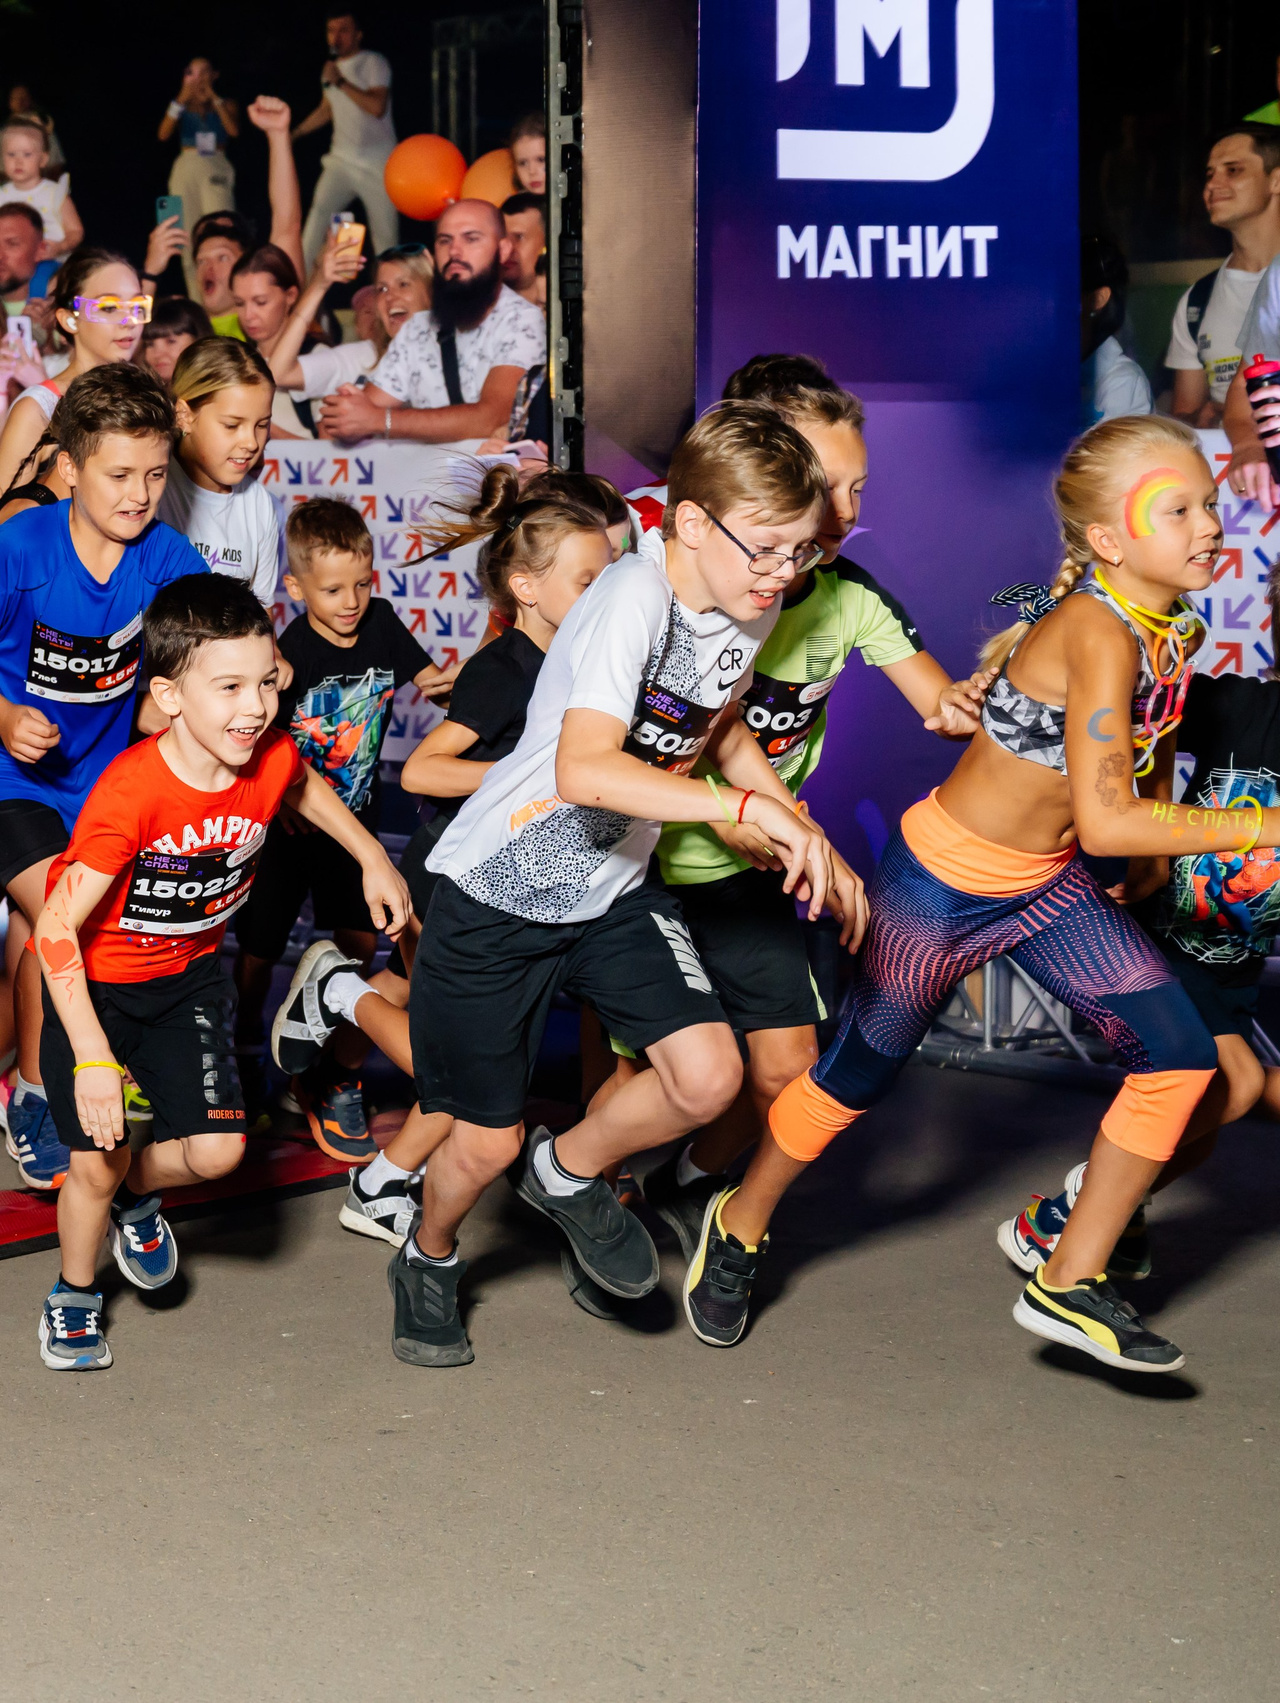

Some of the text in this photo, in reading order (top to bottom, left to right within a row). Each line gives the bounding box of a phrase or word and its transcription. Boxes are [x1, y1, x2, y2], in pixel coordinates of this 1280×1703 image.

[777, 225, 998, 279] МАГНИТ
[222, 547, 242, 562] KIDS
[40, 632, 74, 648] СПАТЬ!
[46, 628, 58, 638] НЕ
[33, 648, 121, 673] 15017
[718, 648, 753, 671] CR7
[31, 670, 58, 684] Глеб
[105, 670, 125, 686] 1,5
[656, 692, 673, 704] НЕ
[644, 695, 686, 719] СПАТЬ!
[1152, 802, 1179, 824] НЕ
[141, 816, 264, 856] HAMPIO
[144, 861, 189, 871] СПАТЬ!
[154, 855, 170, 863] НЕ
[133, 869, 242, 899] 15022
[214, 891, 236, 910] 1,5
[129, 904, 171, 917] Тимур
[208, 1109, 234, 1119] RIDERS
